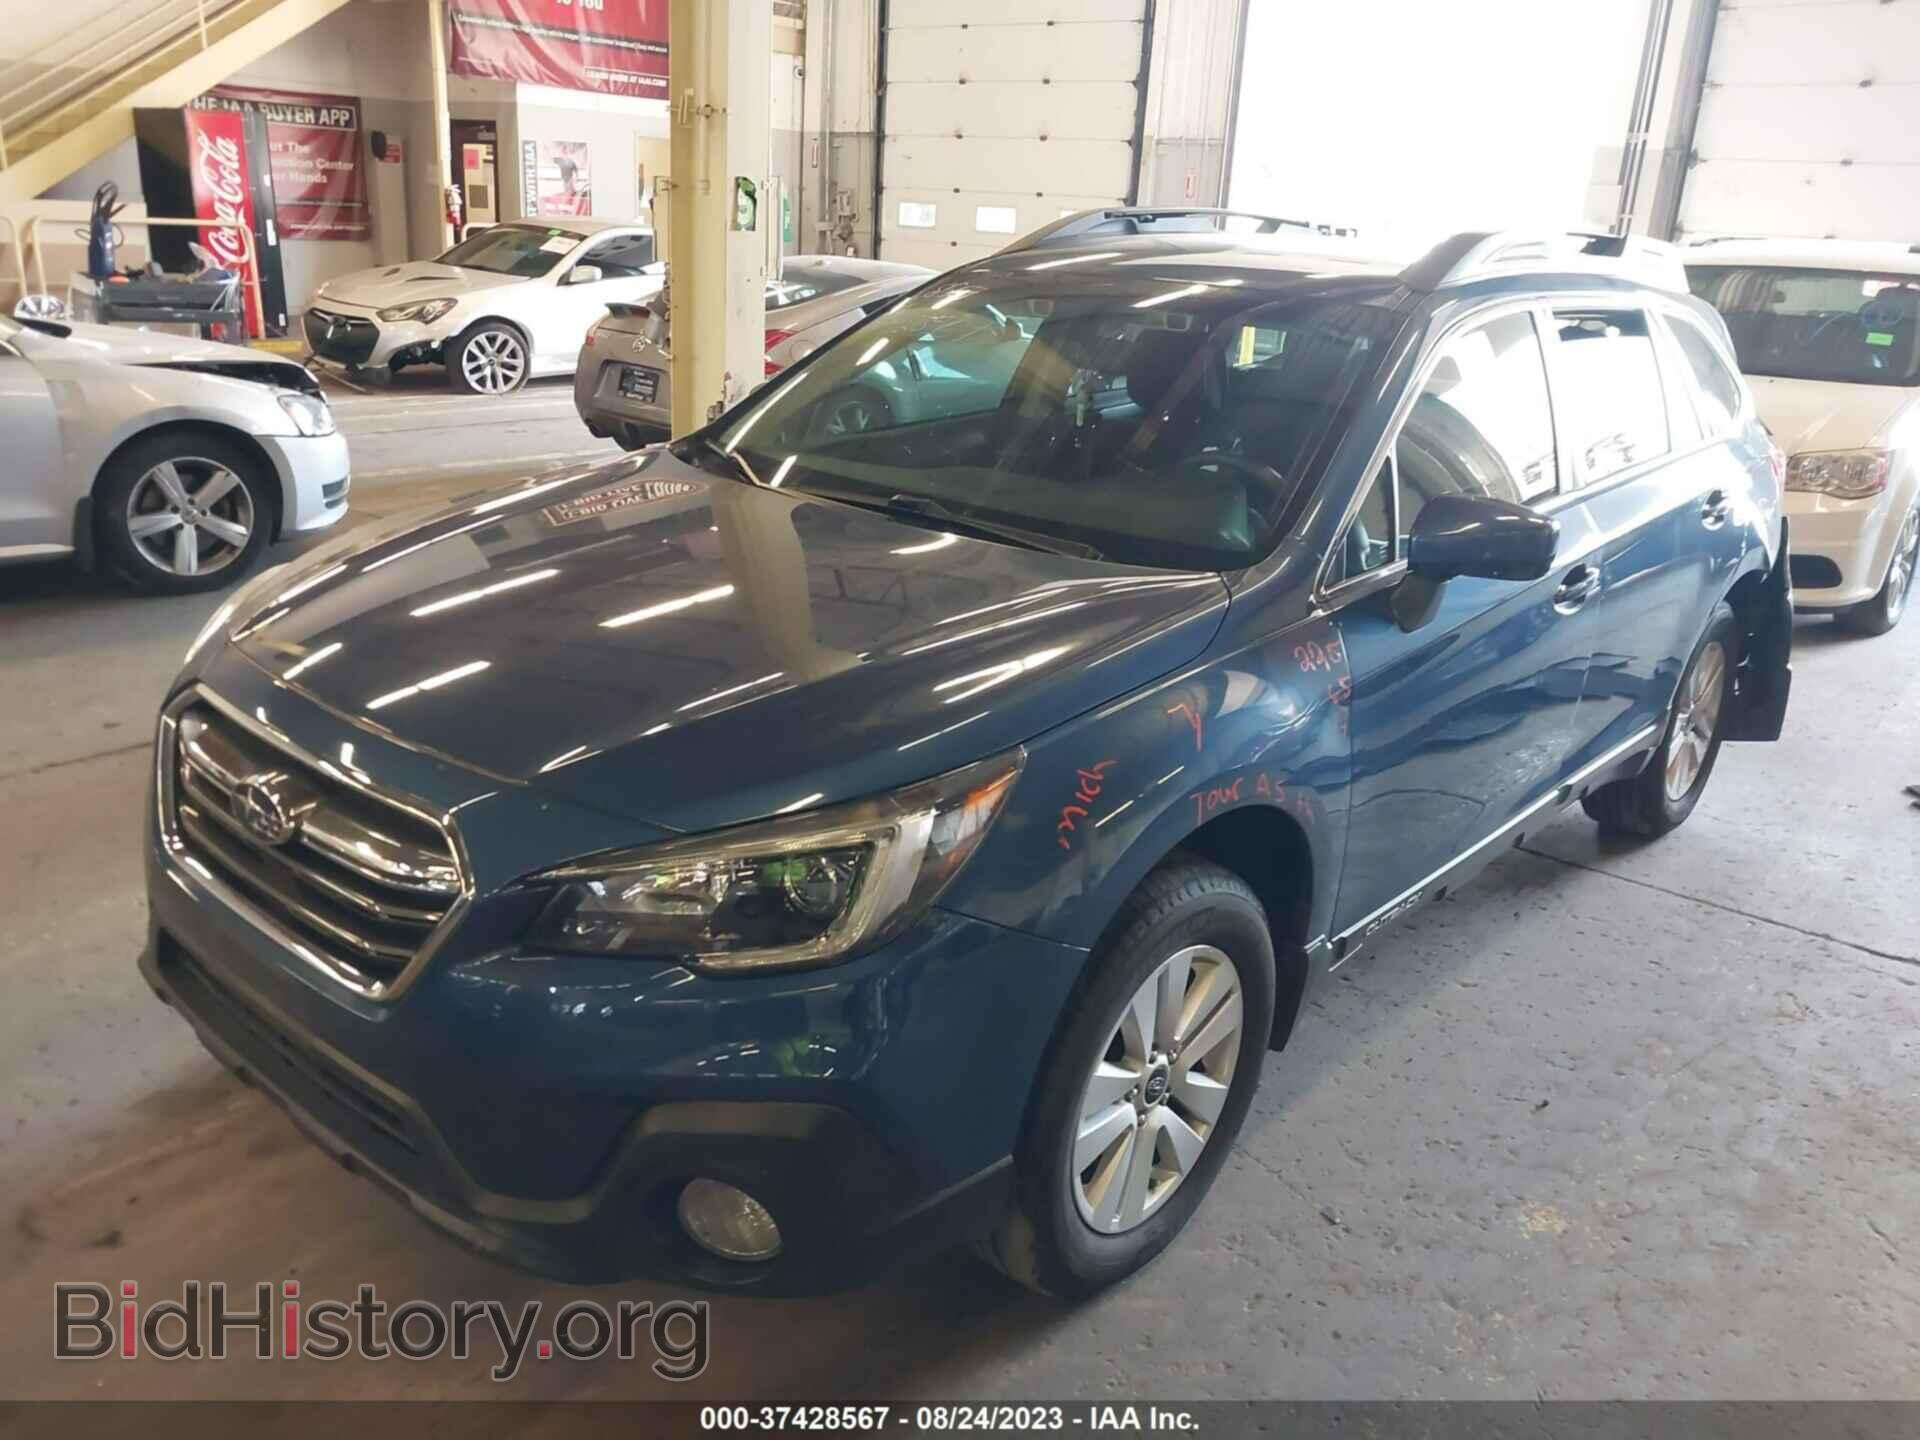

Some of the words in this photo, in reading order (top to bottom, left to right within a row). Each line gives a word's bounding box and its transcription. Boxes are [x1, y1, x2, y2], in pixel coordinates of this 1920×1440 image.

[319, 109, 350, 127] APP
[287, 142, 311, 154] The
[316, 157, 355, 171] Center
[289, 171, 328, 184] Hands
